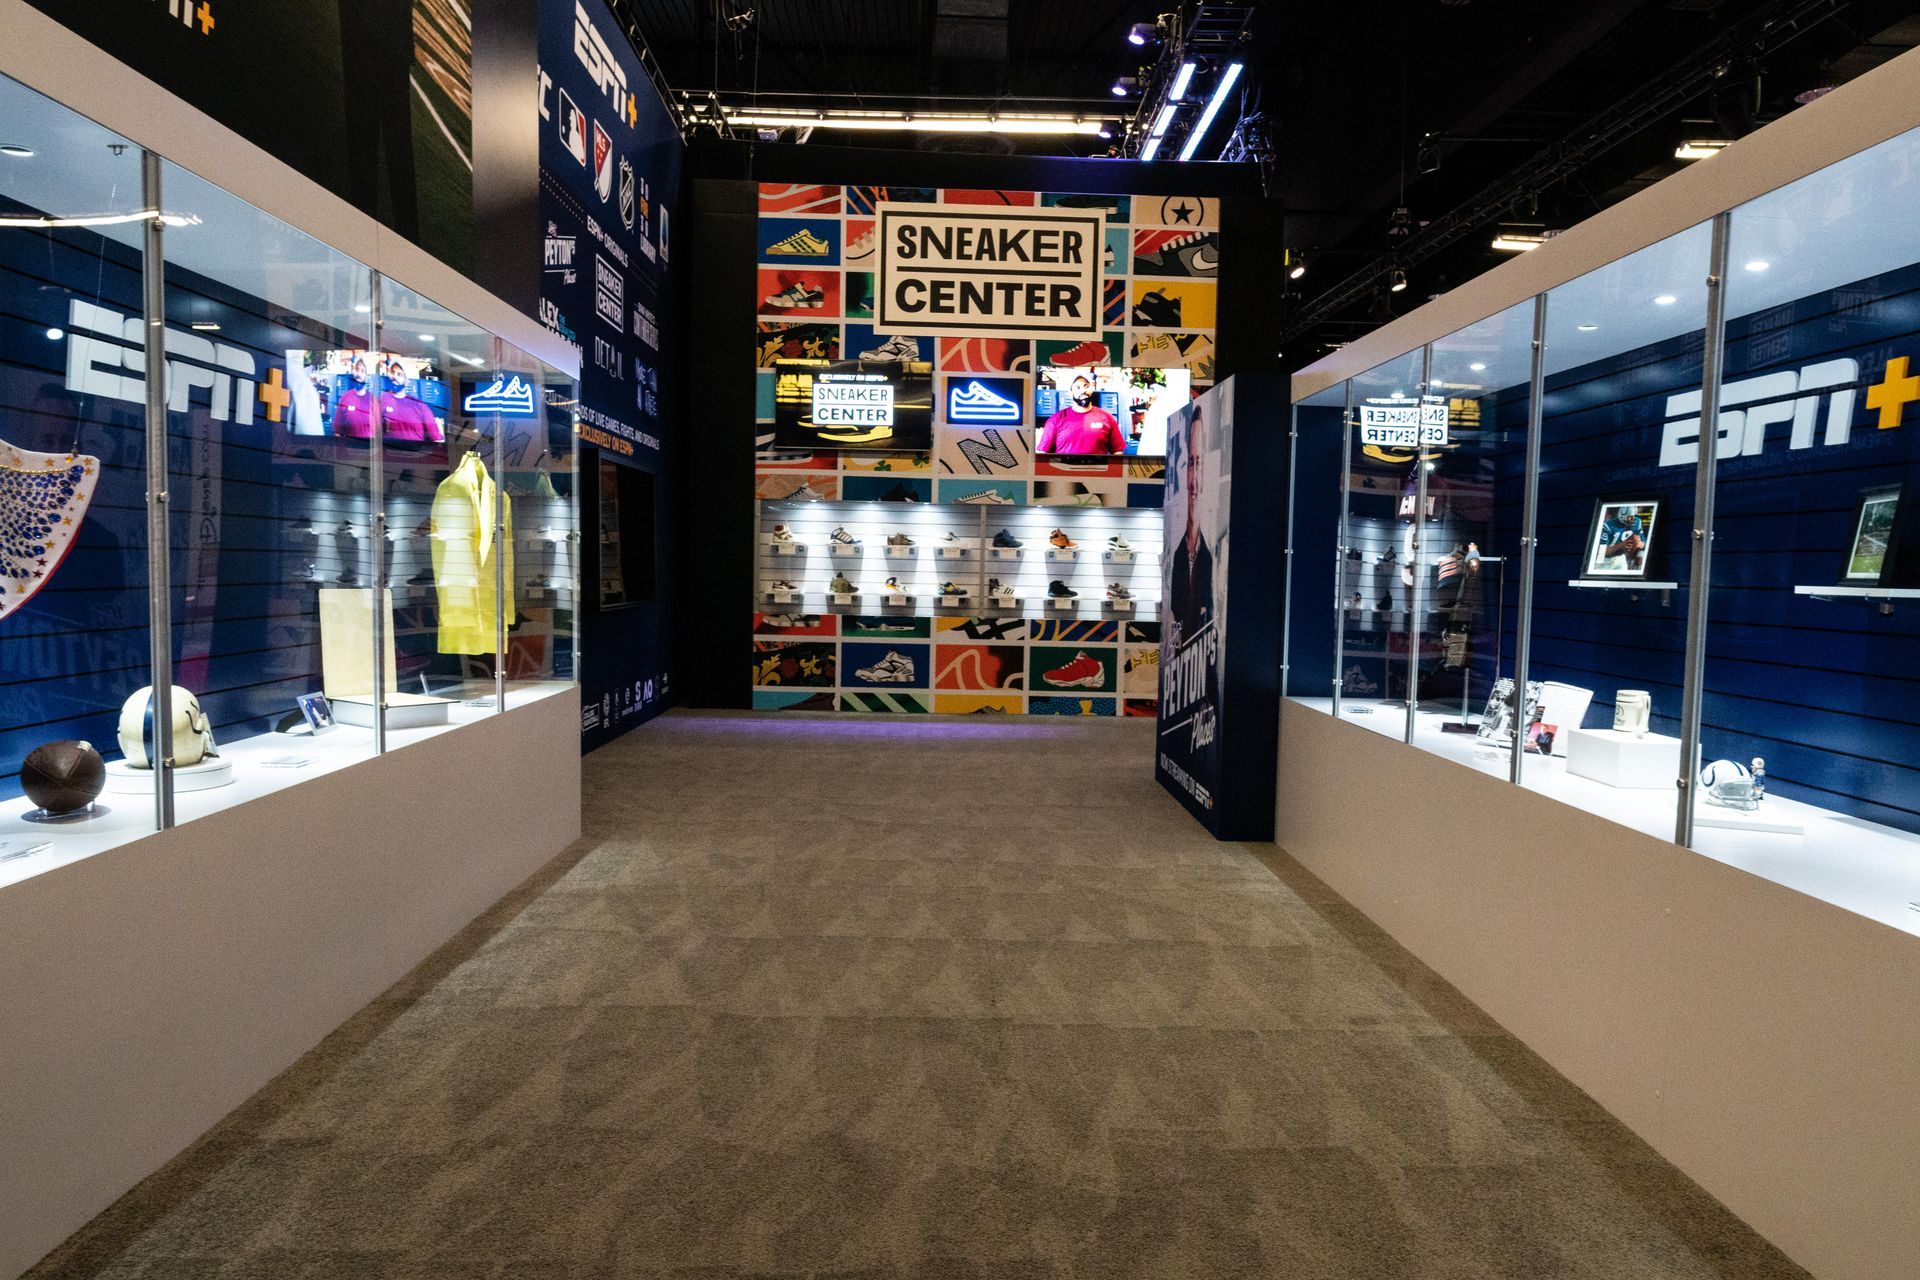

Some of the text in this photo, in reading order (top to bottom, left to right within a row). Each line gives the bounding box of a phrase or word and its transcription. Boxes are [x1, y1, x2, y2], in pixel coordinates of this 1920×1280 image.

[574, 0, 638, 129] ESPN+
[896, 224, 1083, 264] SNEAKER
[598, 262, 622, 299] SNEAKER
[895, 278, 1082, 318] CENTER
[598, 291, 622, 326] CENTER
[65, 298, 291, 425] ESPN+
[818, 387, 888, 402] SNEAKER
[1659, 356, 1920, 468] ESPN+
[818, 408, 887, 422] CENTER
[1162, 628, 1217, 720] PEYTON'S
